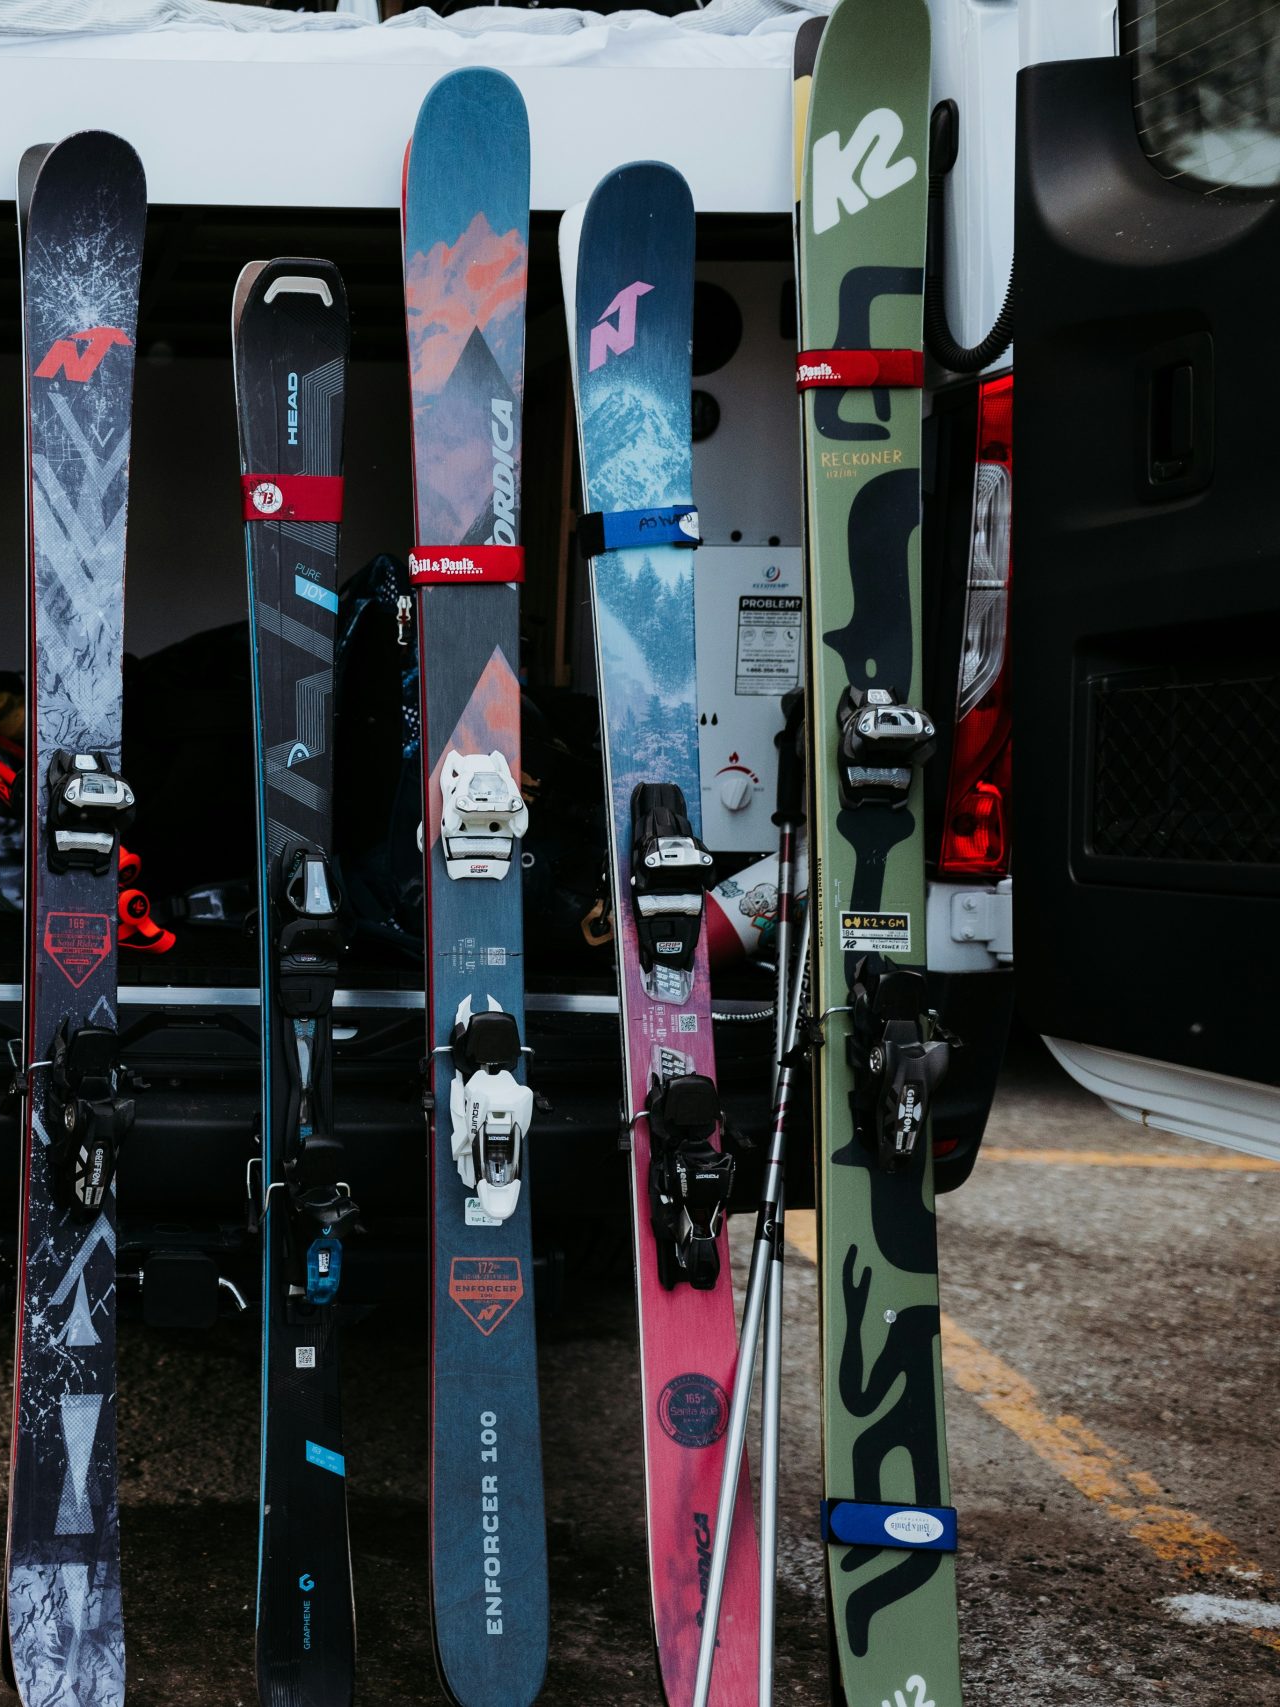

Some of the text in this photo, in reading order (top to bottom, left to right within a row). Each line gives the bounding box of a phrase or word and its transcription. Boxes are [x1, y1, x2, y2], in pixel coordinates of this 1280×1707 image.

[813, 107, 918, 236] K2
[288, 372, 298, 445] HEAD
[821, 449, 902, 467] RECKONER
[295, 563, 321, 581] PURE
[432, 561, 440, 571] &
[302, 584, 327, 601] JOY
[742, 599, 800, 609] PROBLEM?
[842, 929, 854, 937] 184
[843, 940, 857, 949] K2
[480, 1410, 498, 1463] 100
[482, 1475, 503, 1635] ENFORCER
[303, 1600, 311, 1650] GRAPHENE
